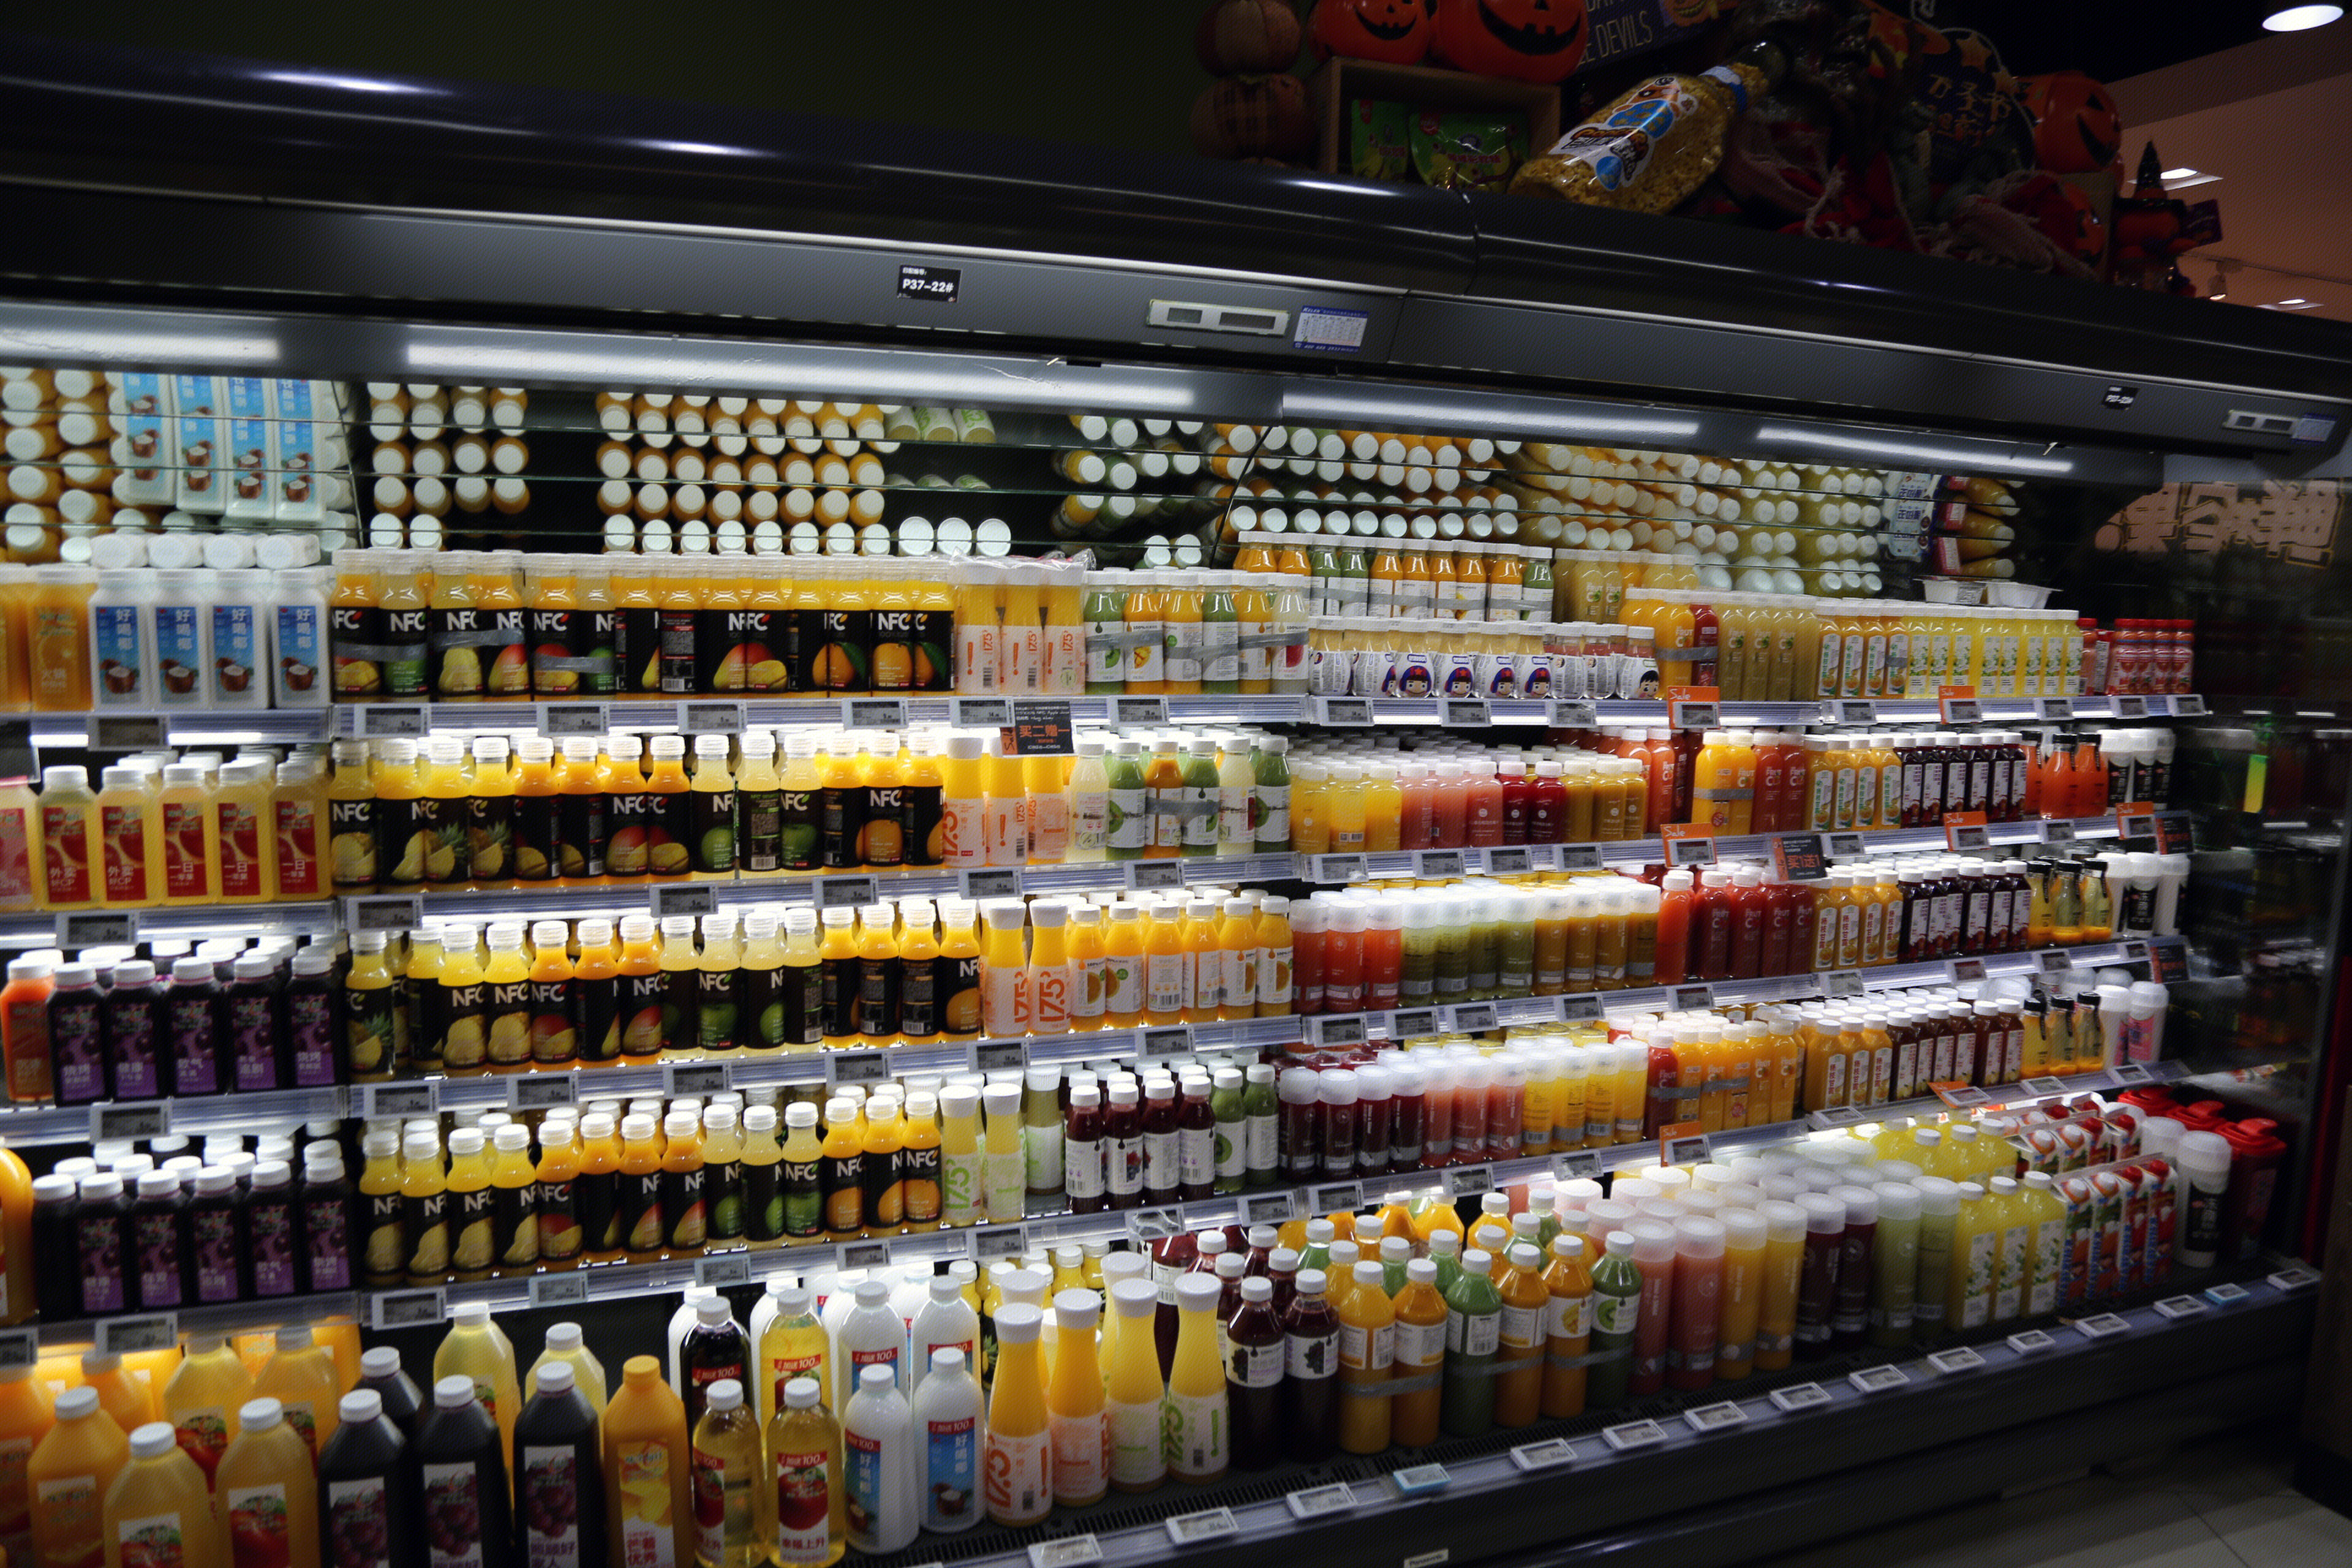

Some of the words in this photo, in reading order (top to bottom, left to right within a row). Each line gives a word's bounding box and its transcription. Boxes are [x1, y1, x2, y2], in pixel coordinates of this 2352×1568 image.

[1596, 10, 1653, 58] DEVILS
[902, 278, 954, 293] P37-22#
[390, 611, 425, 632] NFC
[534, 612, 567, 631] NFC
[878, 612, 910, 631] NFC
[1669, 688, 1691, 700] Sale
[613, 796, 645, 815] NFC
[870, 790, 901, 807] NFC
[333, 802, 369, 821] NFC
[1664, 824, 1686, 837] Sale
[699, 973, 730, 992] NFC
[494, 983, 528, 1004] NFC
[532, 984, 565, 1003] NFC
[907, 1150, 937, 1168] NFC
[785, 1163, 817, 1182] NFC
